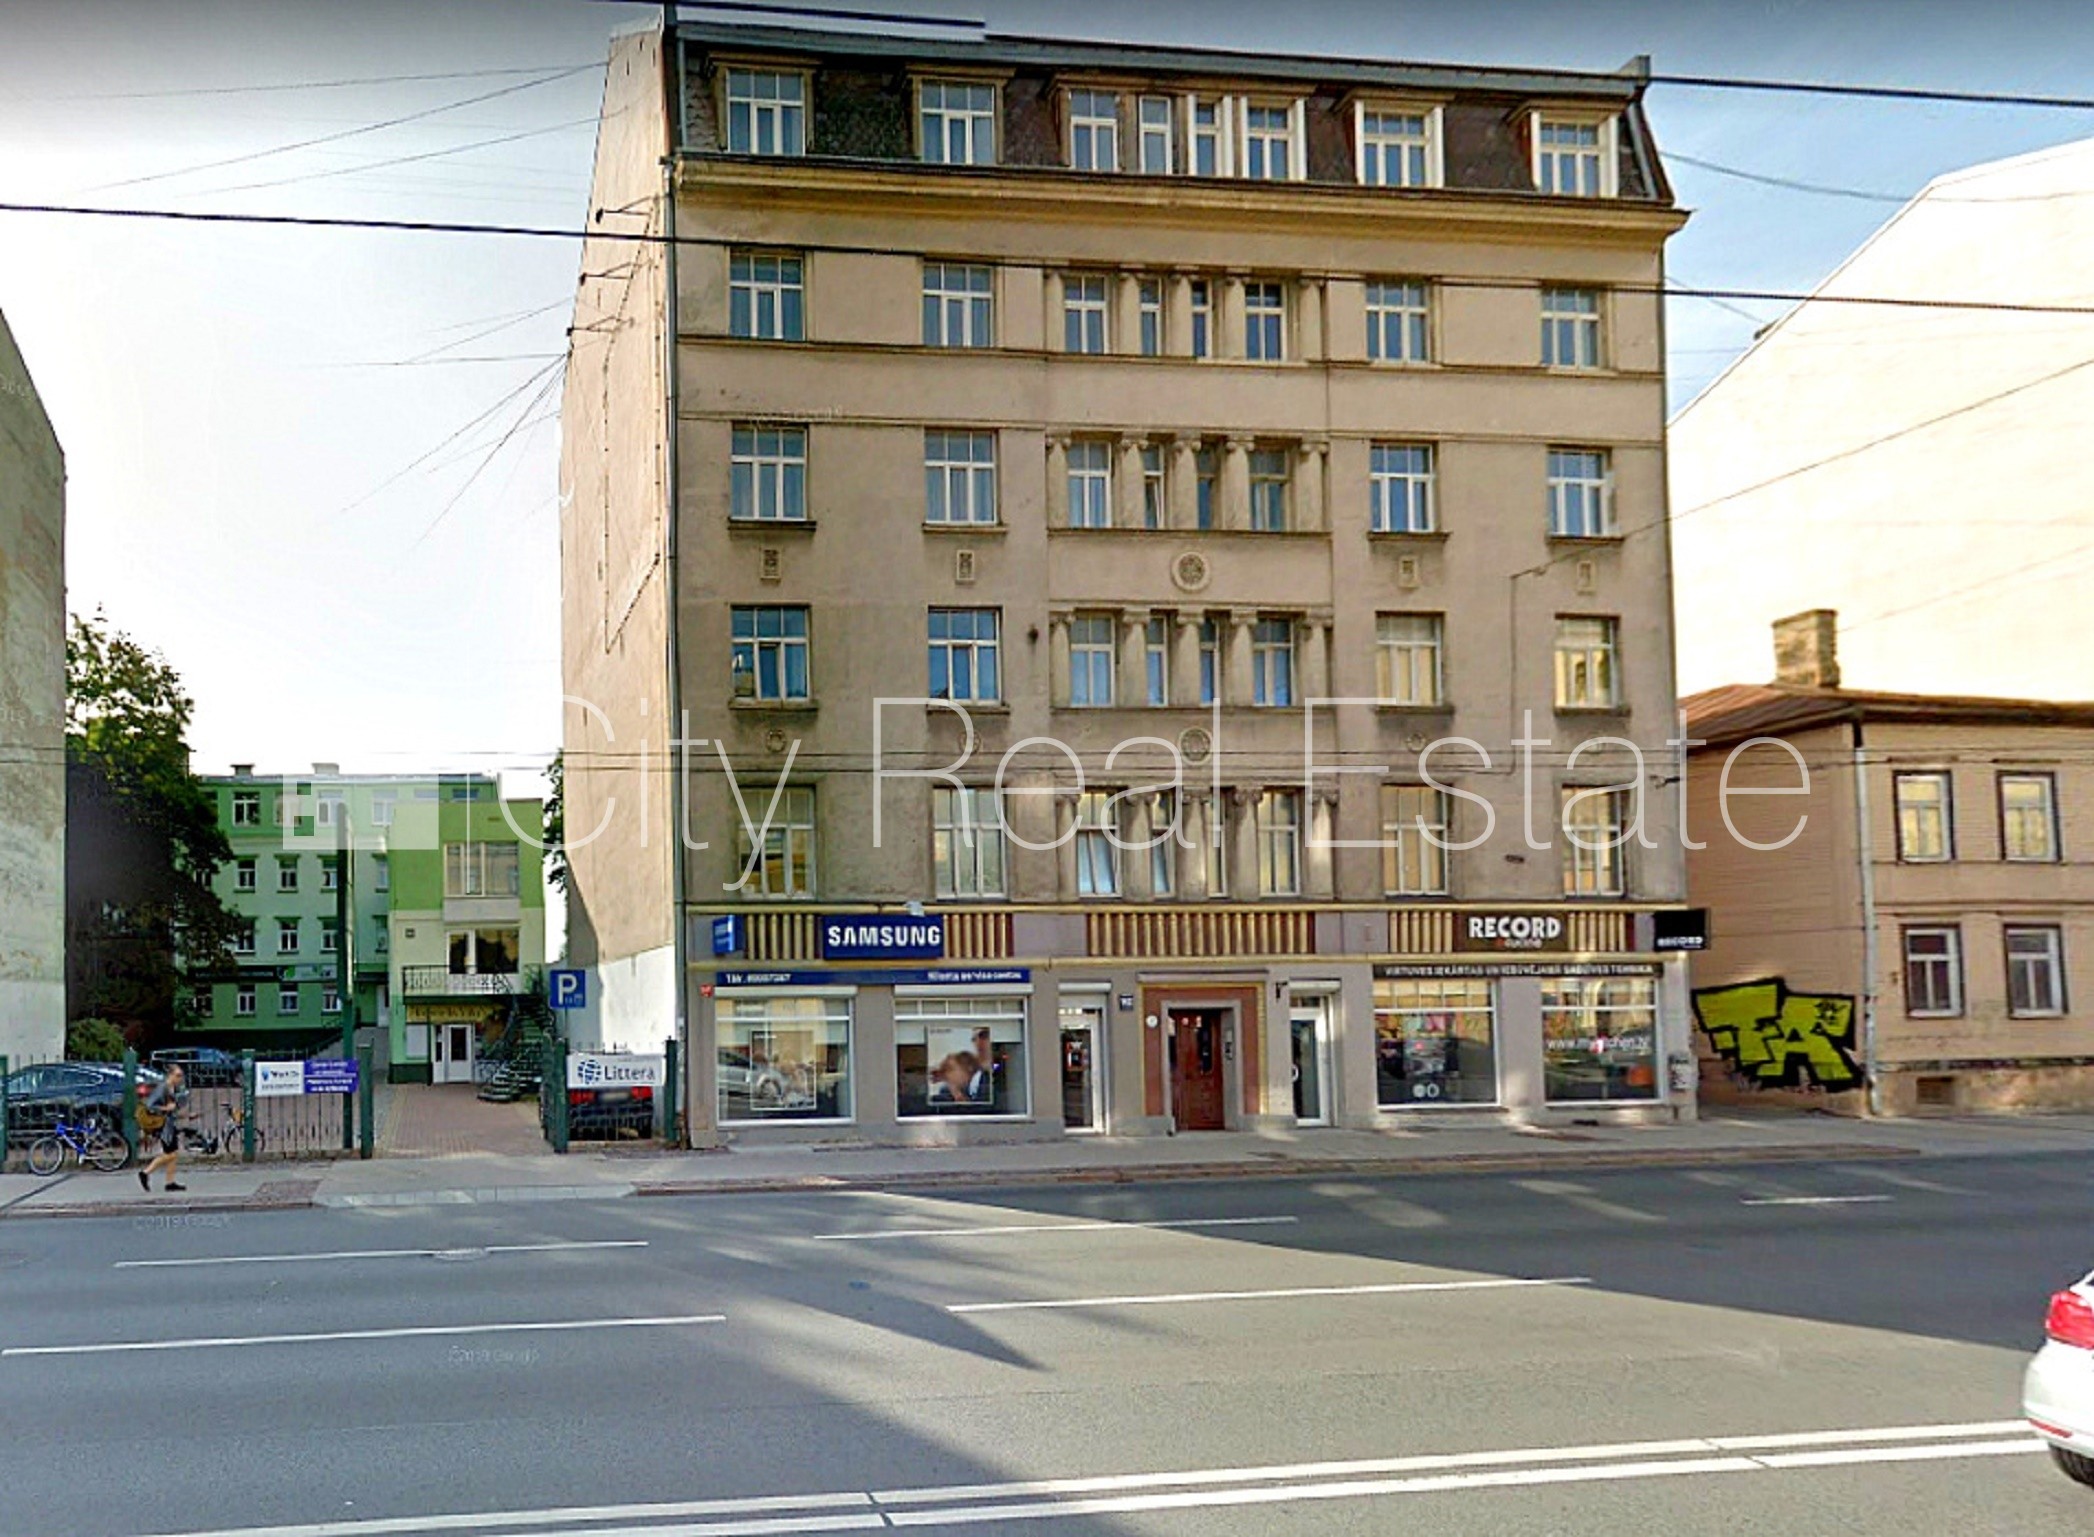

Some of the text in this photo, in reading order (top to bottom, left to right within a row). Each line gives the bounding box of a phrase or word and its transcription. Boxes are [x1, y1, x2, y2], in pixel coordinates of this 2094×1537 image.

[828, 925, 941, 947] SAMSUNG
[1468, 916, 1561, 939] RECORD
[558, 974, 577, 1005] P
[604, 1065, 656, 1080] Littera
